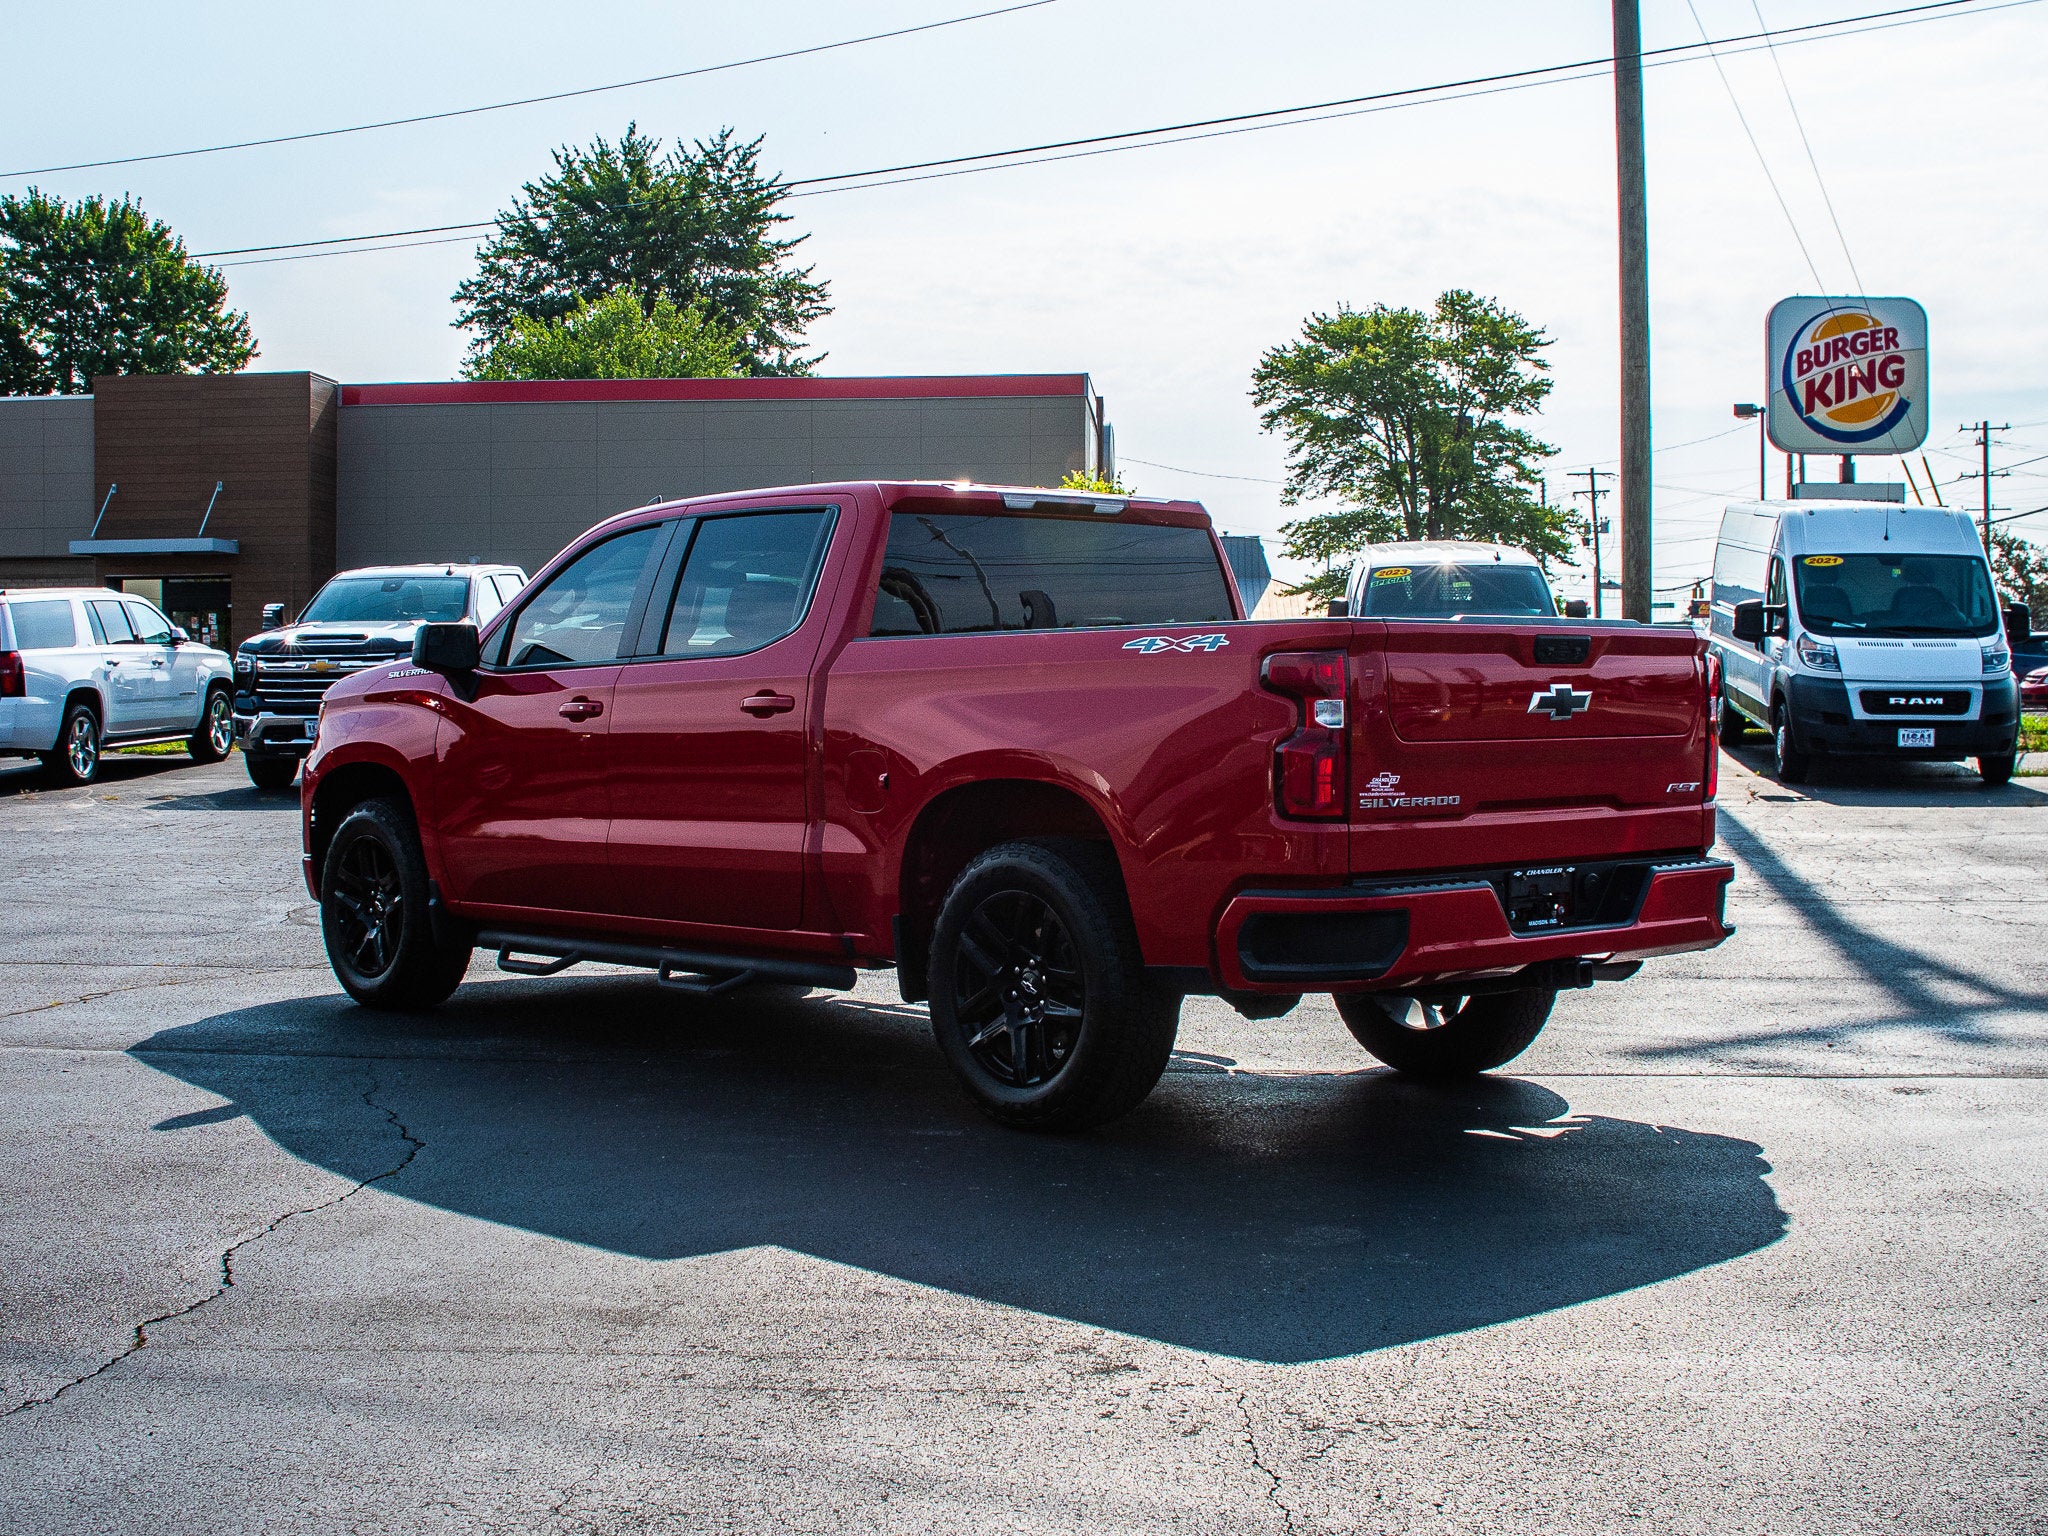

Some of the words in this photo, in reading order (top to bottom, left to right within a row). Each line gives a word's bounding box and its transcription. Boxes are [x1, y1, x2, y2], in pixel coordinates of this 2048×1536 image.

[1796, 327, 1900, 378] BURGER
[1804, 354, 1905, 416] KING
[1807, 557, 1839, 565] 2021
[1378, 568, 1408, 577] 2023
[1371, 576, 1410, 587] SPECIAL
[388, 668, 434, 679] SILVERA
[1889, 697, 1944, 705] RAM
[1666, 782, 1700, 793] RST
[1359, 795, 1461, 809] SILVERADO
[1526, 867, 1563, 876] CHANDLER
